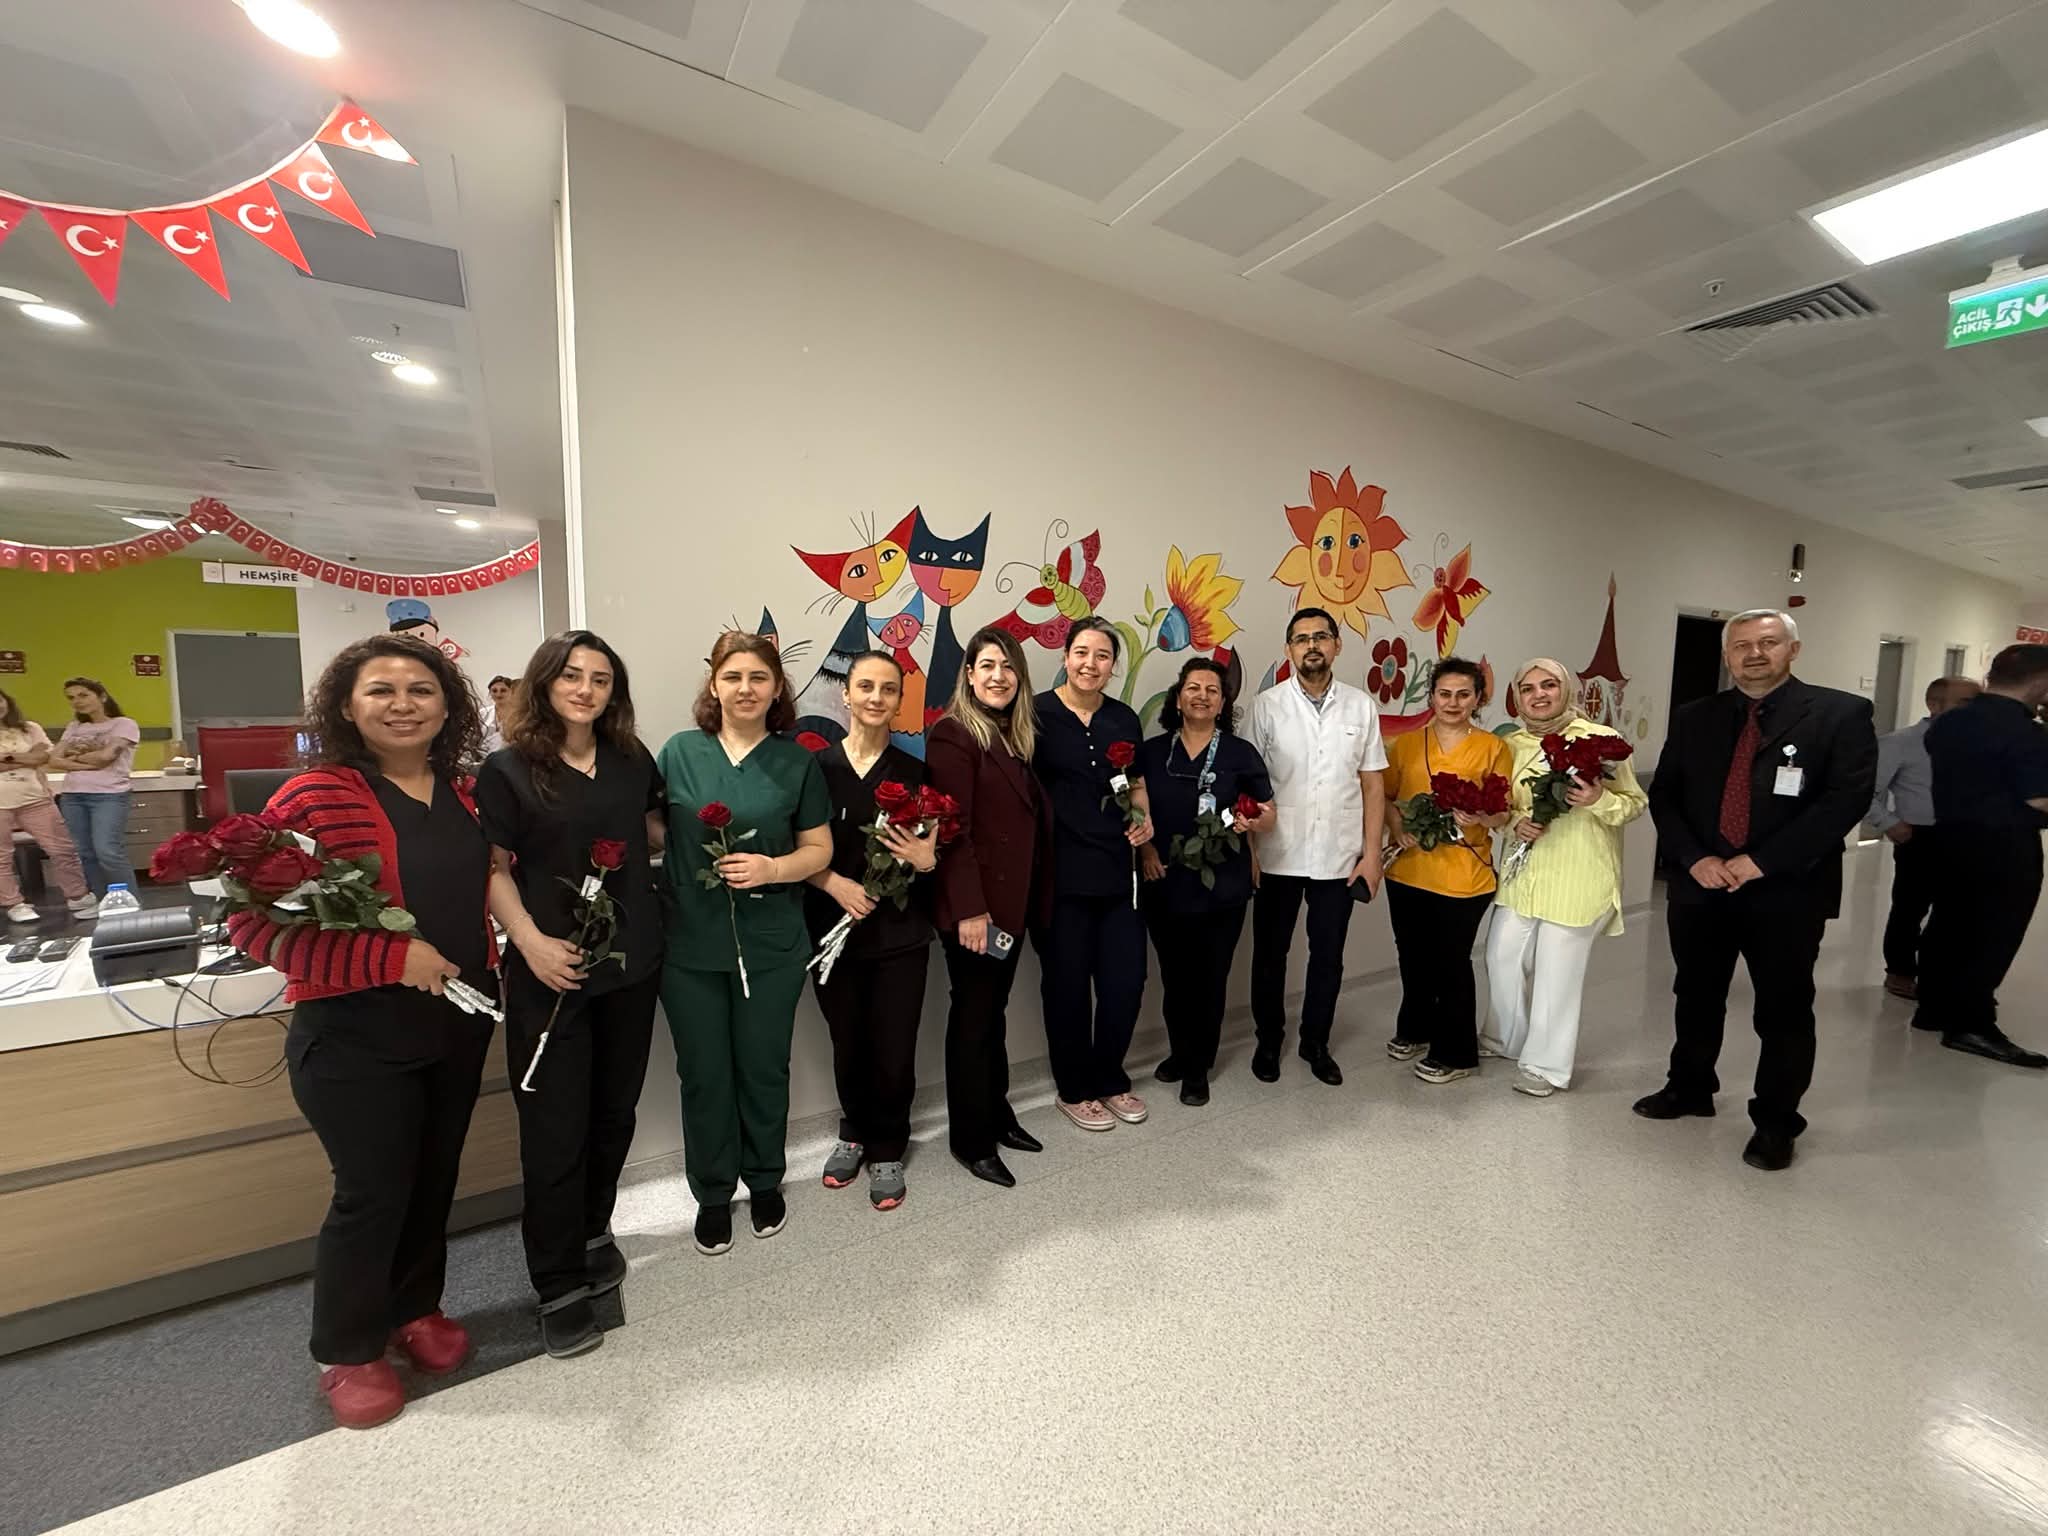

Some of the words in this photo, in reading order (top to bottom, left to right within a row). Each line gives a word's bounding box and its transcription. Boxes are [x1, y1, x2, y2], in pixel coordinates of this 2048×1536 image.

[1957, 308, 1990, 324] ACİL
[1953, 319, 1992, 338] ÇIKIŞ
[239, 570, 299, 583] HEMŞİRE
